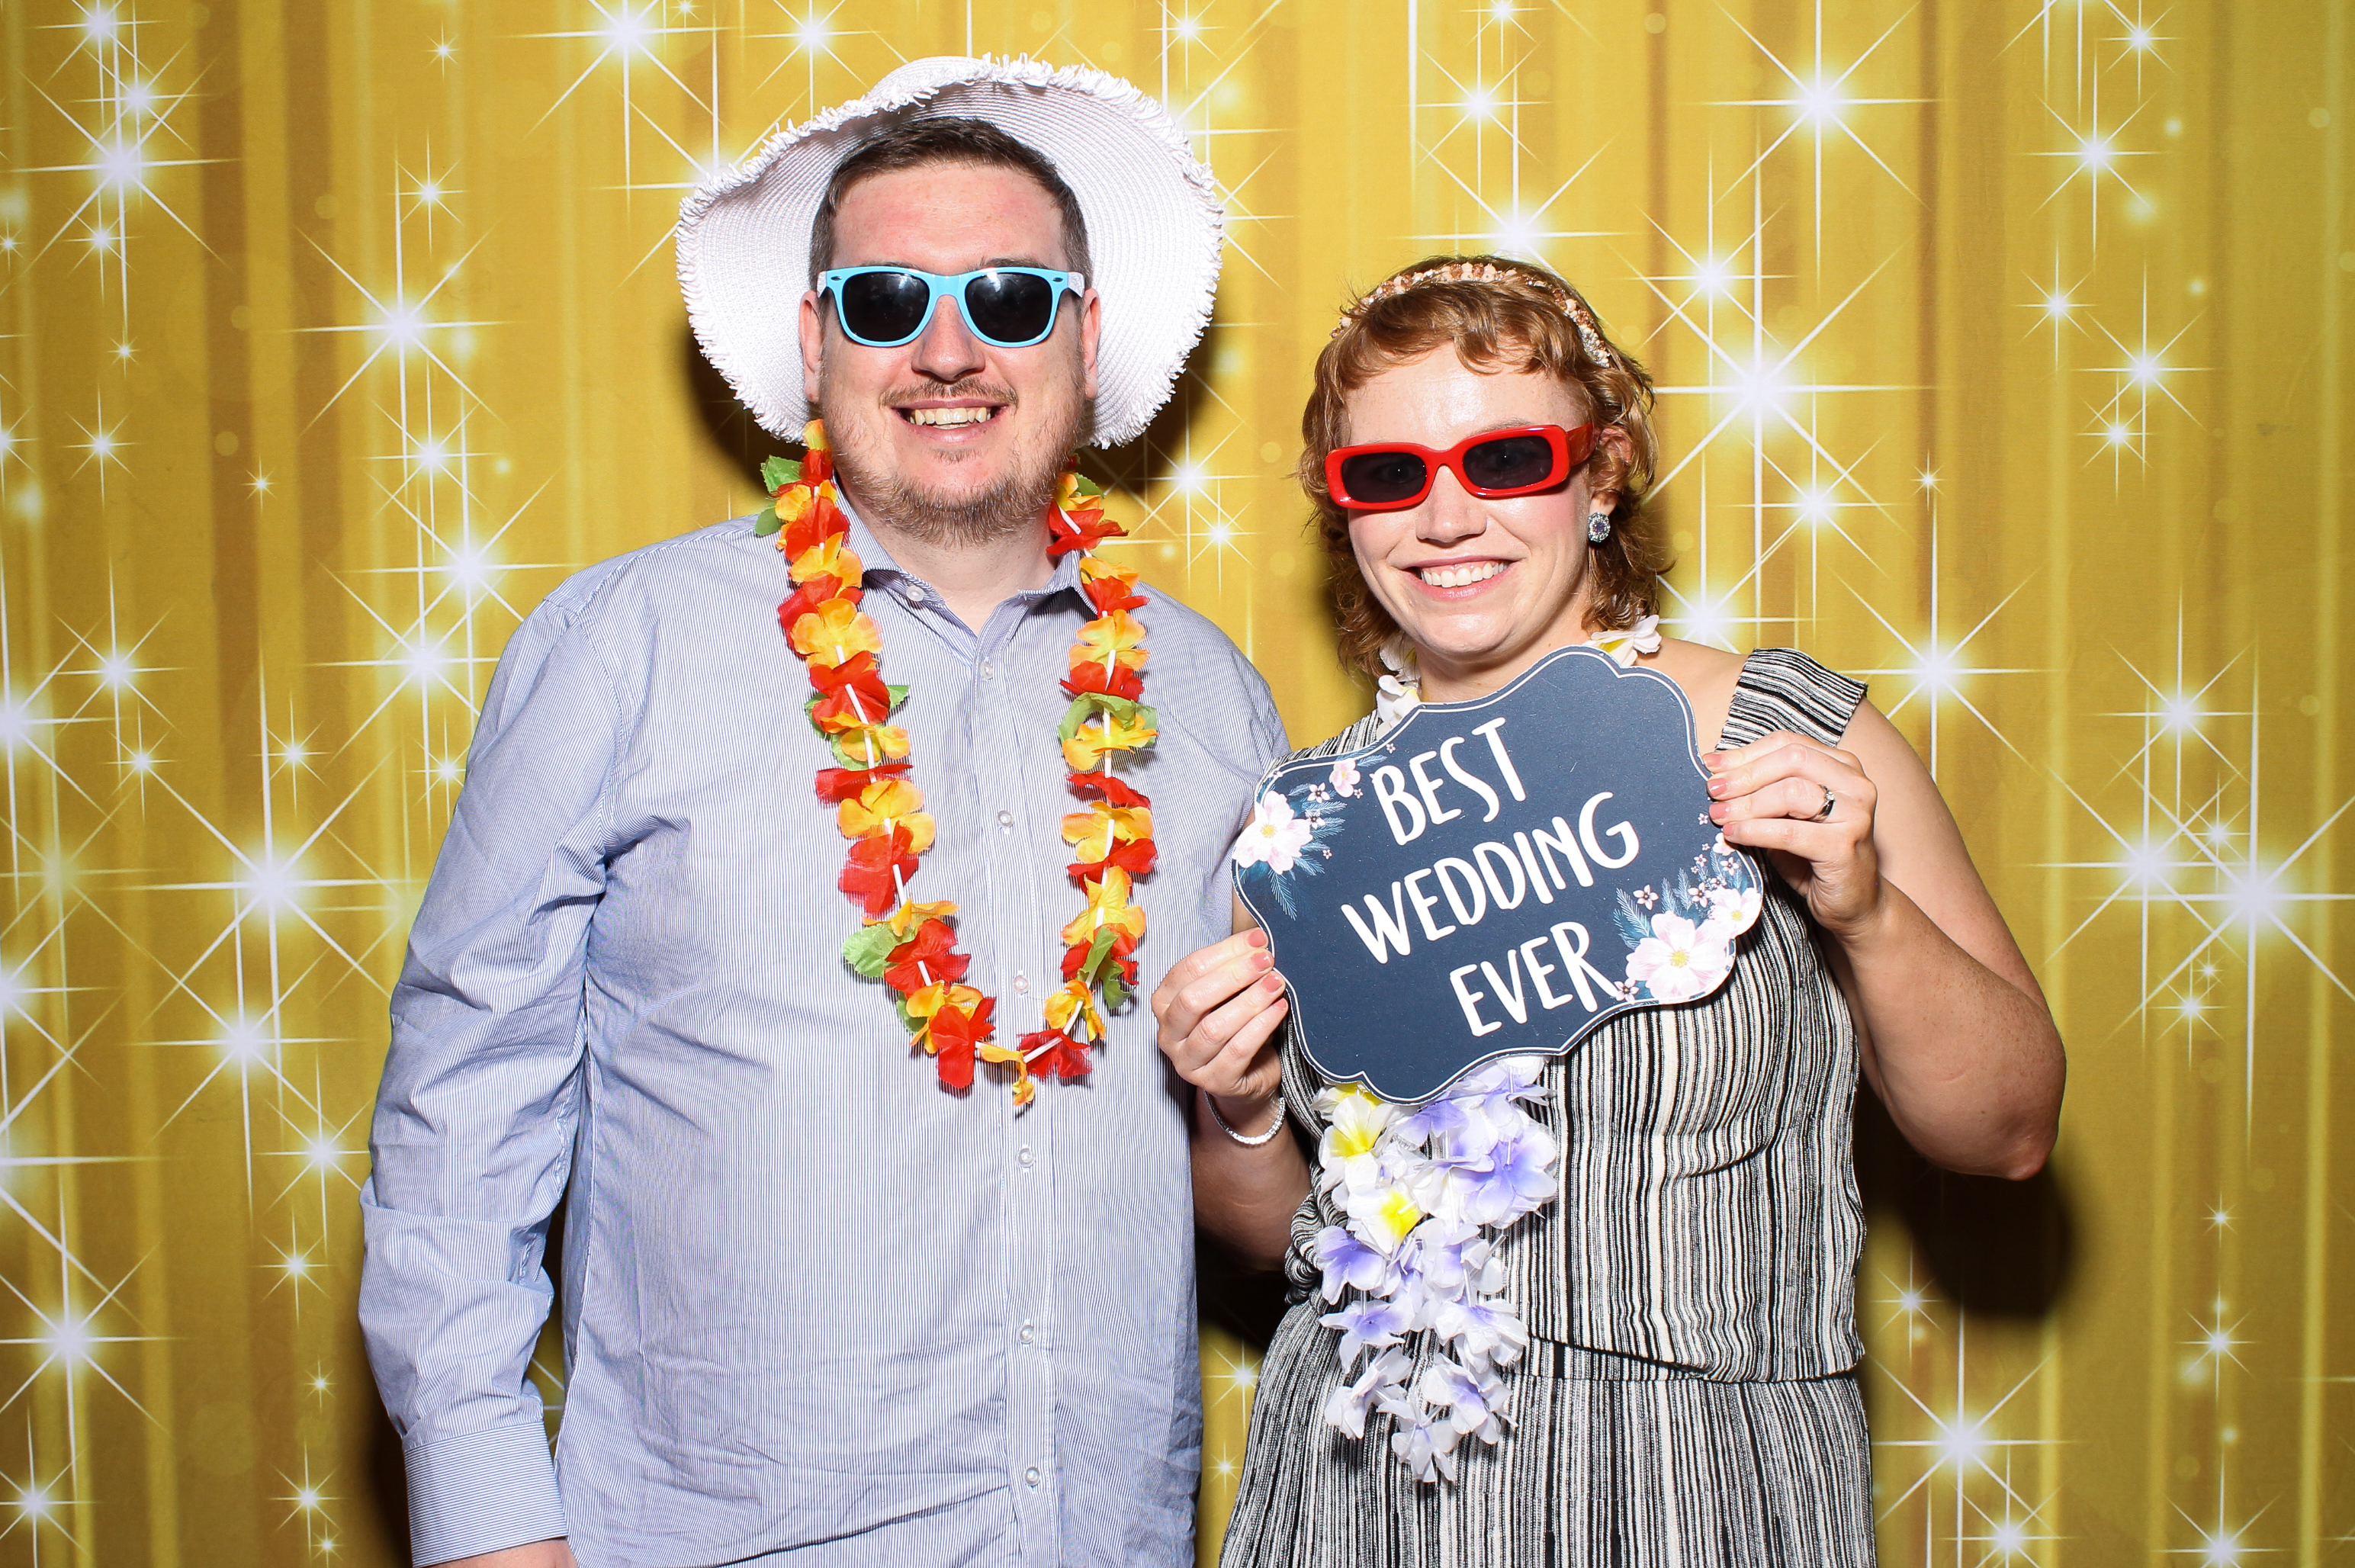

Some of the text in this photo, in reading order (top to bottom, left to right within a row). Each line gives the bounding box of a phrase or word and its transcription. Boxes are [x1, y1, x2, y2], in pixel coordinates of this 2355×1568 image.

[1371, 717, 1526, 846] BEST
[1341, 791, 1640, 964] WEDDING
[1449, 921, 1618, 1037] EVER
